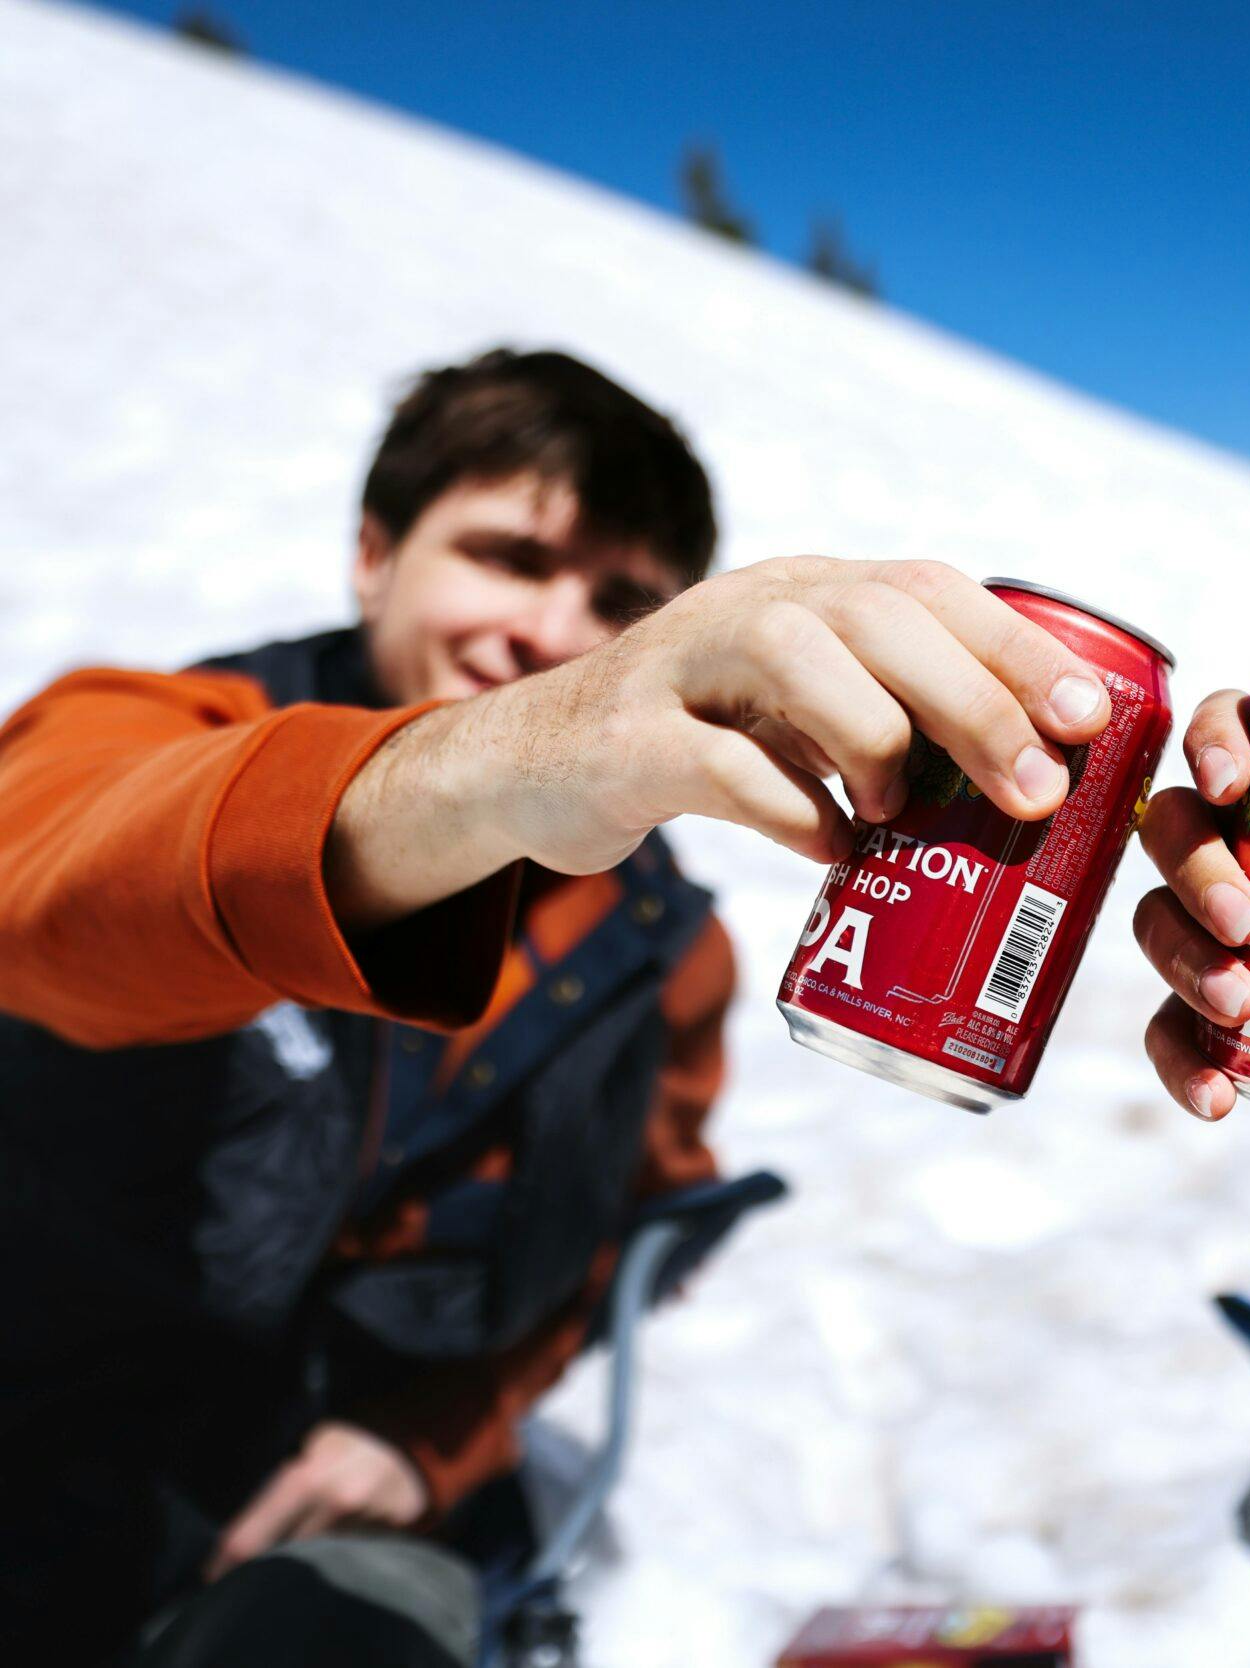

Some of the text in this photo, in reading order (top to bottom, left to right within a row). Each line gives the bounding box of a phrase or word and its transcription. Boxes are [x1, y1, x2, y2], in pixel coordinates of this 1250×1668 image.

[1043, 843, 1065, 886] PREGNANCY
[1061, 809, 1079, 842] BECAUSE
[1076, 796, 1085, 808] OF
[1081, 780, 1092, 794] THE
[1088, 761, 1100, 778] RISK
[1095, 748, 1105, 760] OF
[1101, 724, 1115, 747] BIRTH
[1051, 838, 1077, 890] CONSUMPTION
[1073, 822, 1084, 834] OF
[1080, 778, 1102, 820] ALCOHOLIC
[1098, 736, 1119, 776] BEVERAGES
[1116, 704, 1133, 733] IMPAIRS
[1070, 853, 1080, 865] TO
[1075, 831, 1089, 853] DRIVE
[1088, 807, 1099, 823] CAR
[1099, 762, 1117, 794] OPERATE
[1130, 702, 1142, 719] AND
[1137, 685, 1147, 702] MAY
[1034, 853, 1051, 882] WOMEN
[1046, 822, 1063, 853] SHOULD
[1059, 805, 1070, 822] NOT
[852, 870, 911, 905] HOP
[818, 983, 829, 994] CA
[829, 988, 836, 997] &
[836, 990, 862, 1007] MILLS
[863, 1001, 893, 1022] RIVER,
[895, 1014, 911, 1027] NC
[1010, 1011, 1018, 1019] 0
[1016, 960, 1039, 1000] 83783
[1034, 920, 1055, 957] 22824
[956, 1028, 979, 1044] PLEASE
[1006, 1024, 1019, 1035] ALE
